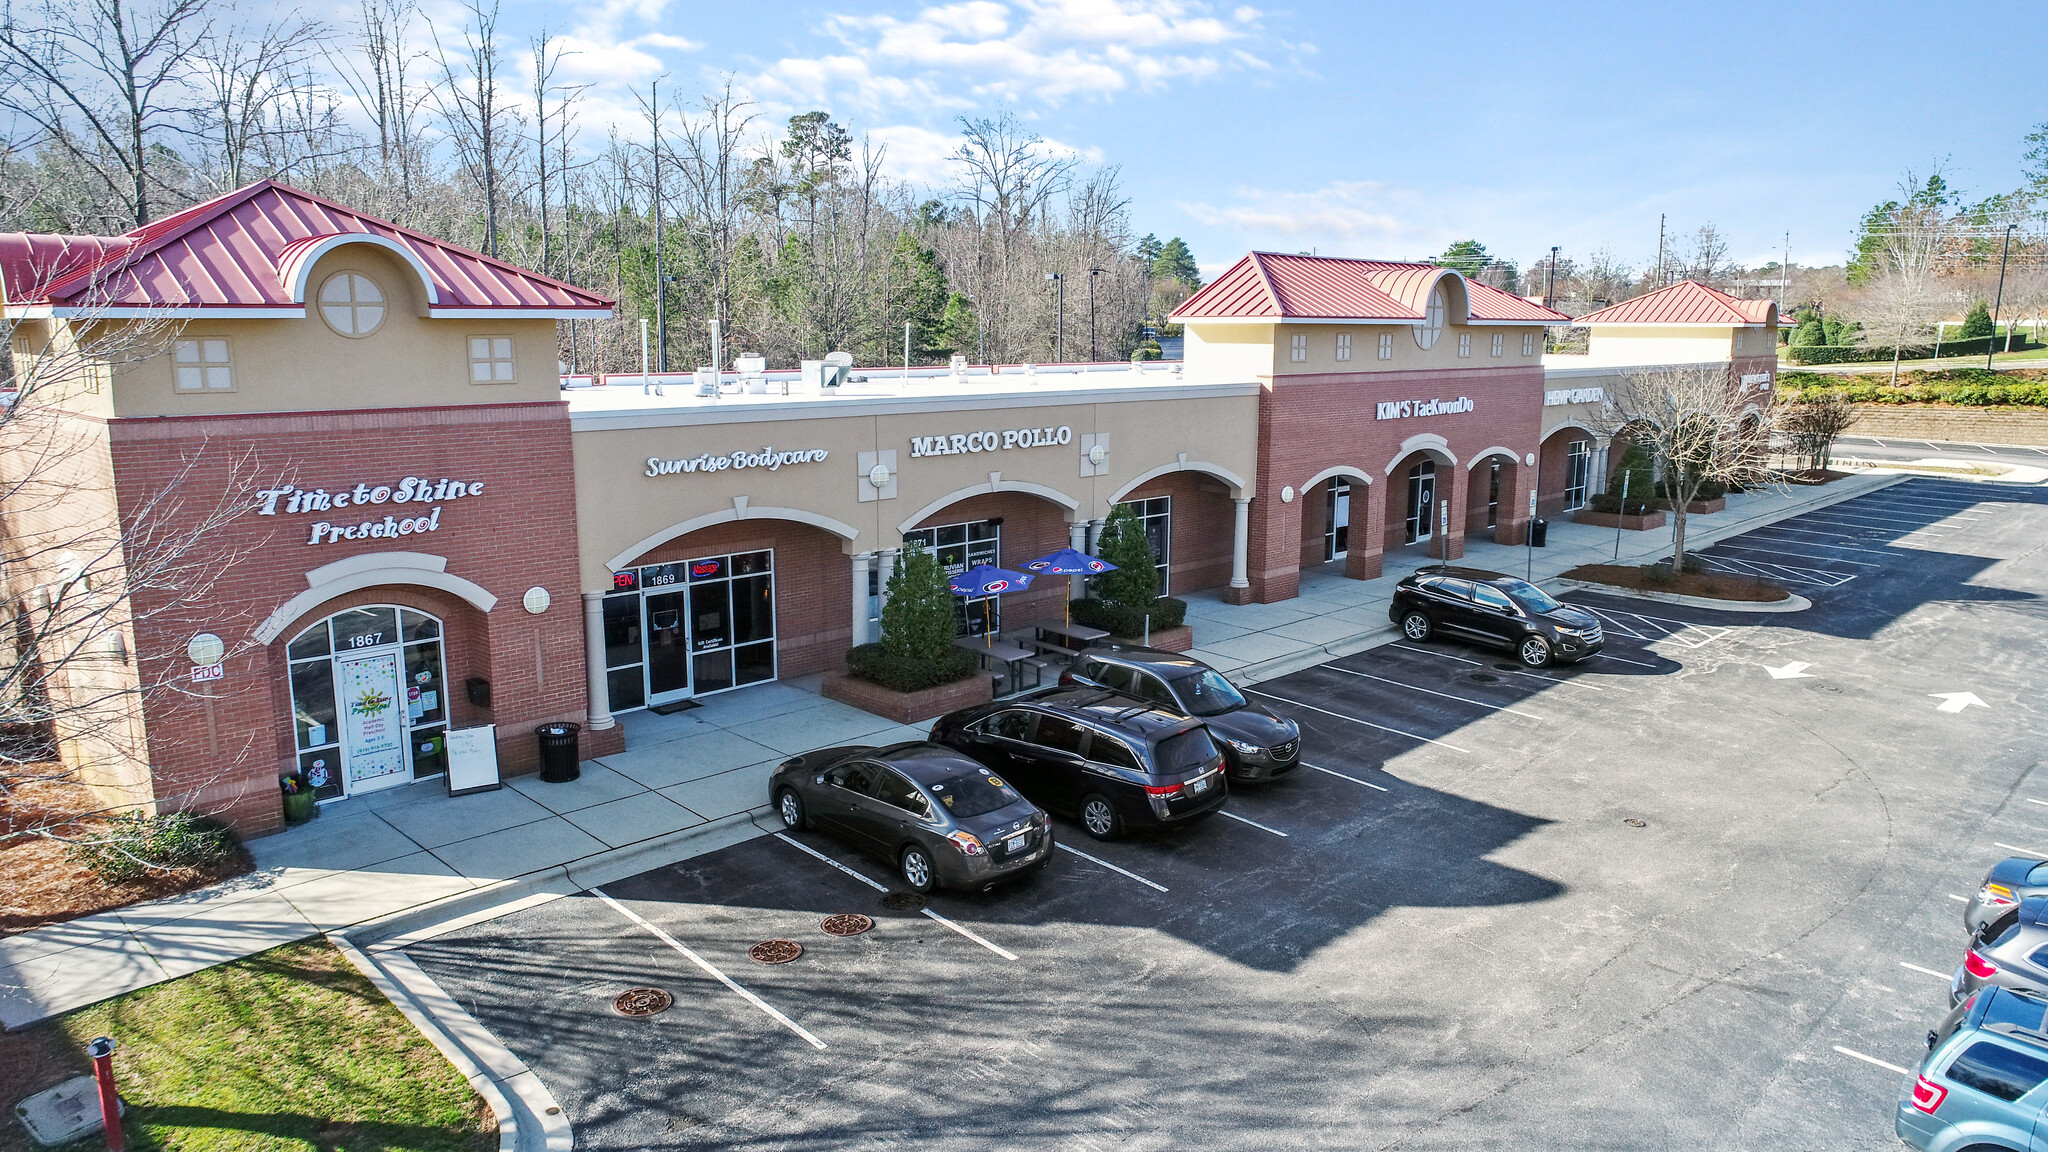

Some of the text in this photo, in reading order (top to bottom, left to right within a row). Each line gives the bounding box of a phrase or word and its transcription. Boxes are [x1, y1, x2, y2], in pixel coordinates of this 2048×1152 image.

[1376, 396, 1474, 420] KIM'S TaeKwonDo
[911, 425, 1072, 458] MARCO POLLO
[645, 446, 829, 478] Sunrise Bodycare
[255, 476, 484, 516] Time to Shine
[307, 506, 442, 545] Preschool
[968, 549, 995, 557] SANDWICHES
[972, 557, 993, 566] WRAPS
[693, 564, 718, 574] Massage
[613, 573, 633, 586] PEN
[651, 574, 675, 586] 1869
[348, 632, 383, 648] 1867
[408, 690, 419, 698] STOP
